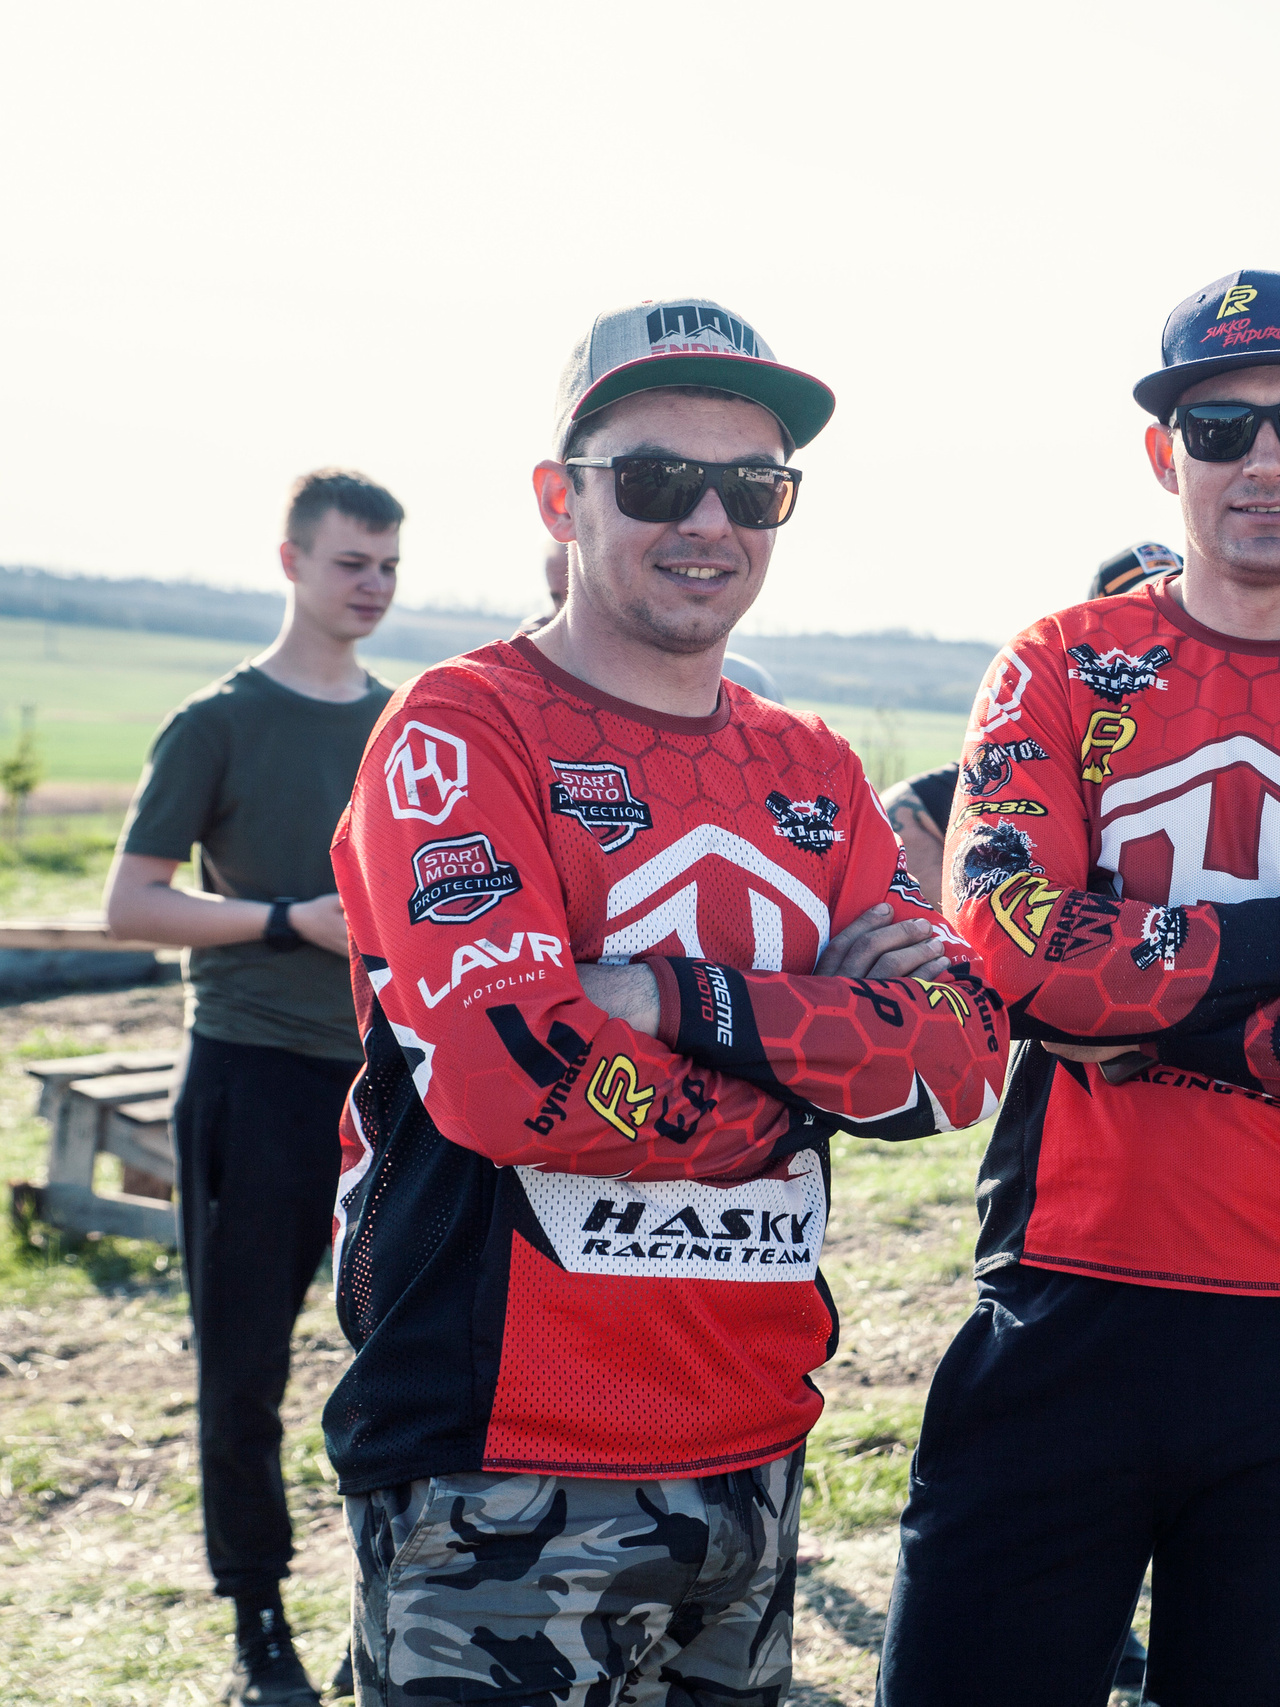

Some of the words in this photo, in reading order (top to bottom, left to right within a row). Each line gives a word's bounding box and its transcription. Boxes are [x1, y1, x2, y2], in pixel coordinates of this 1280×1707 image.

[1200, 318, 1251, 343] SUKKO
[1067, 667, 1170, 691] EXTREME
[560, 771, 617, 788] START
[562, 785, 620, 801] MOTO
[558, 792, 645, 821] PTECTION
[423, 844, 481, 869] START
[425, 860, 486, 885] MOTO
[412, 872, 514, 915] PROTECTION
[416, 931, 565, 1009] LAVR
[462, 968, 547, 1009] MOTOLINE
[691, 964, 715, 1022] MOTO
[1128, 1070, 1233, 1095] ACING
[580, 1198, 814, 1245] HASKY
[580, 1238, 732, 1263] RACING
[740, 1247, 811, 1265] TEAM
